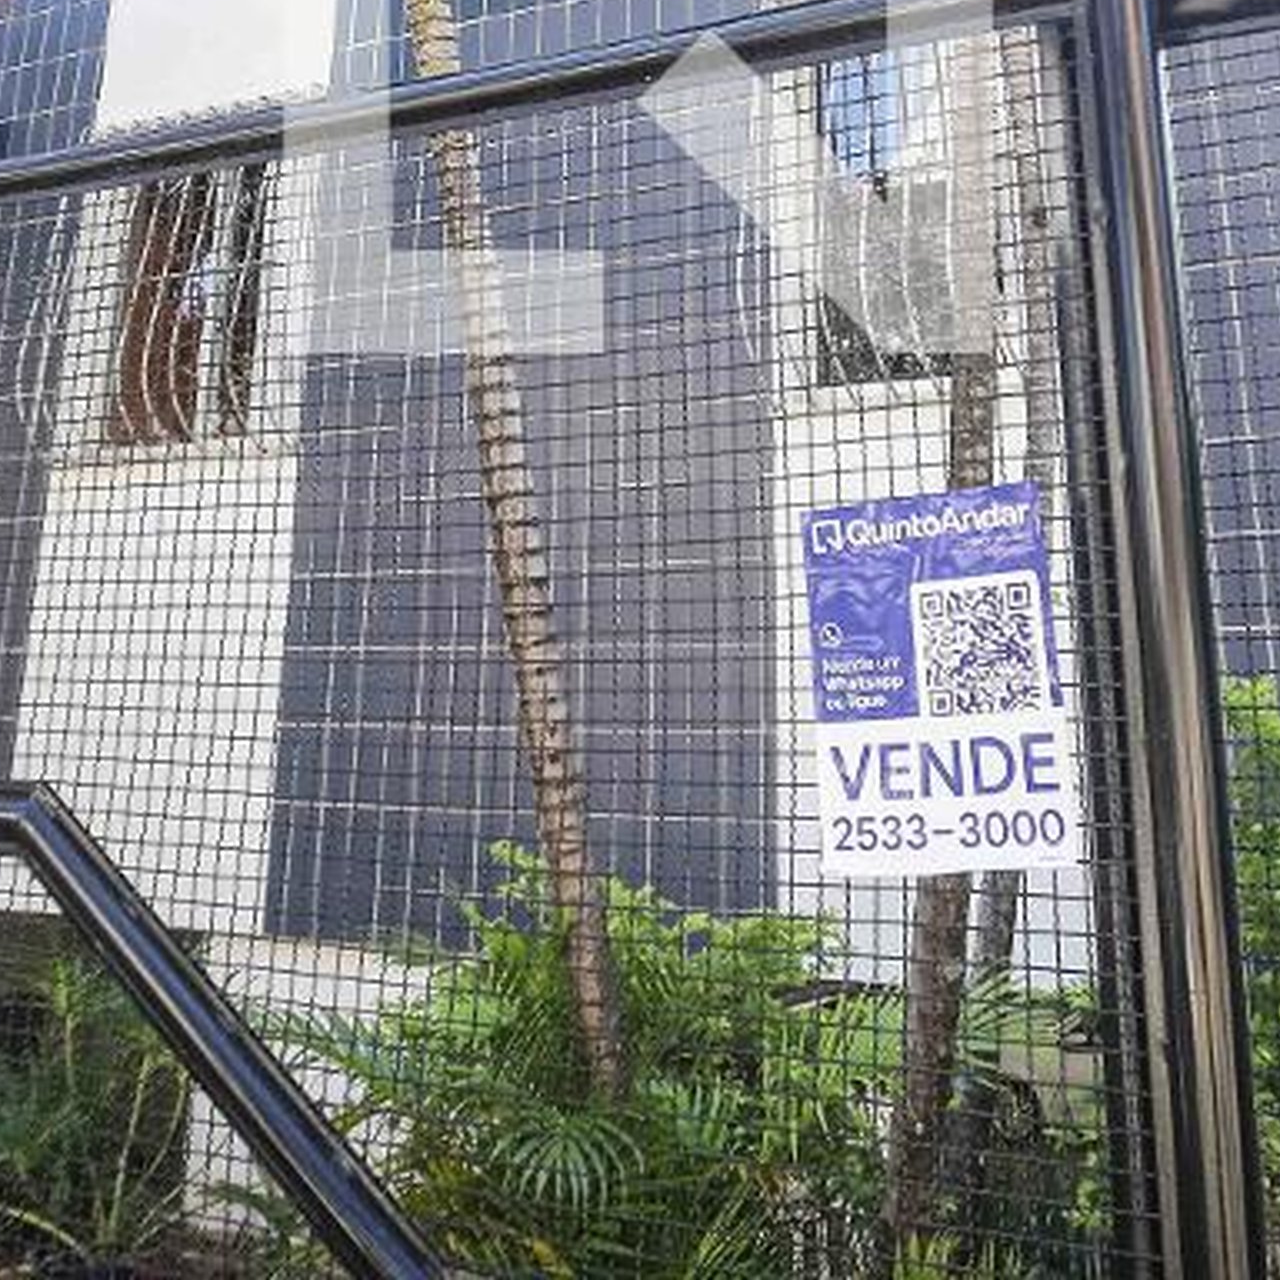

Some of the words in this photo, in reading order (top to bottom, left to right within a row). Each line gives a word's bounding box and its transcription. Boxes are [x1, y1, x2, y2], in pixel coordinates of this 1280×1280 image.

[846, 502, 1030, 545] QuintoAndar
[830, 732, 1061, 801] VENDE
[832, 809, 1066, 852] 2533-3000
